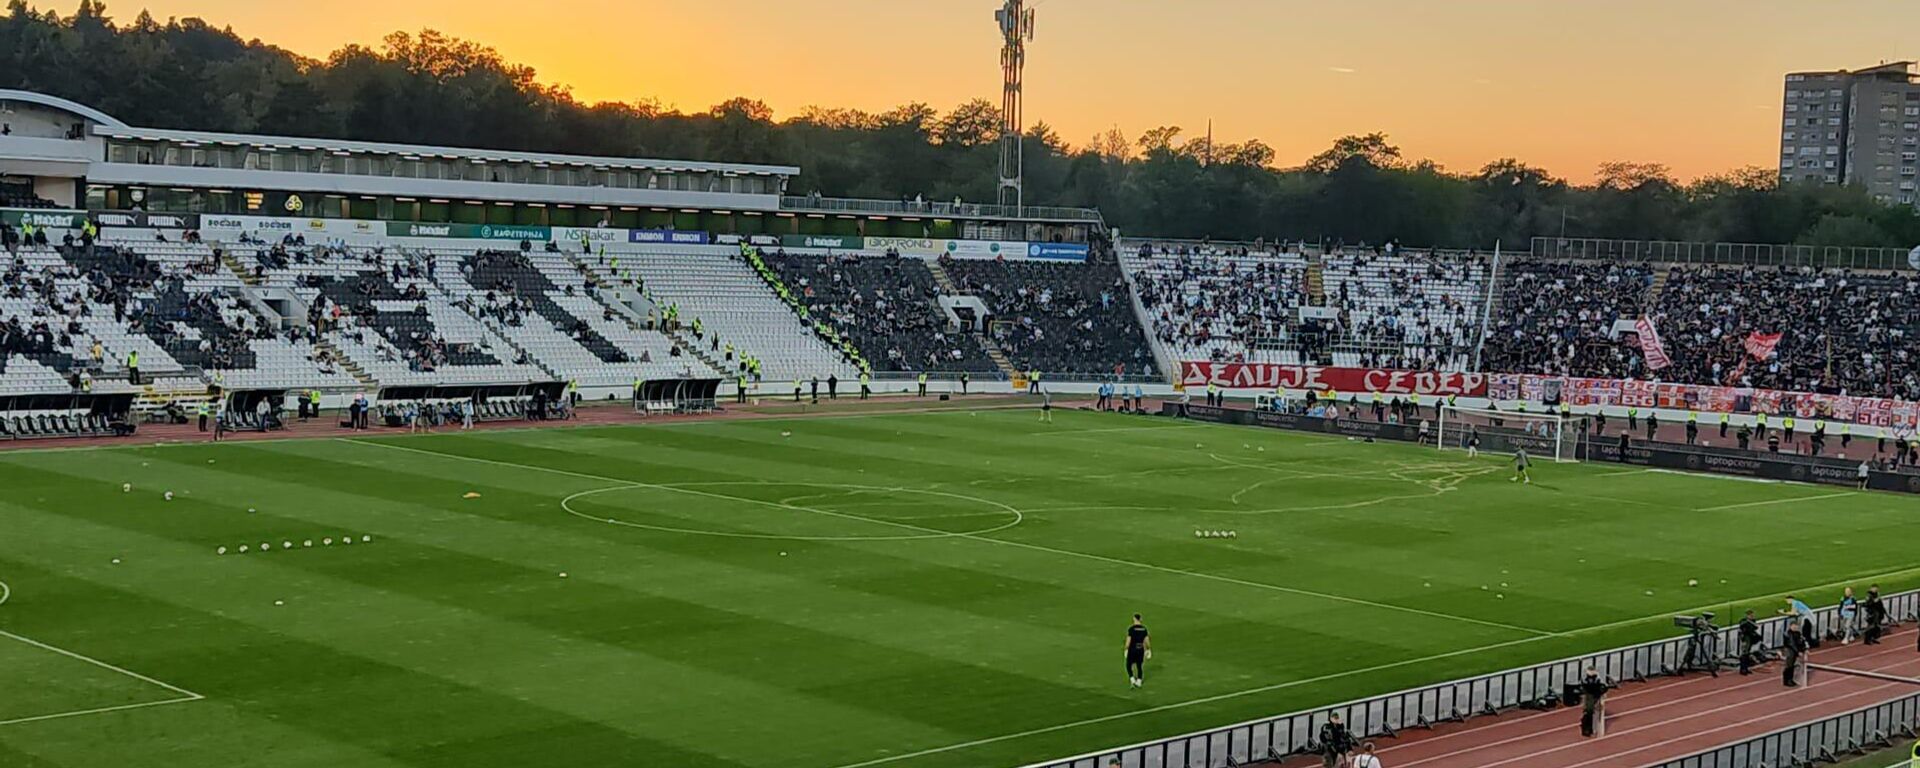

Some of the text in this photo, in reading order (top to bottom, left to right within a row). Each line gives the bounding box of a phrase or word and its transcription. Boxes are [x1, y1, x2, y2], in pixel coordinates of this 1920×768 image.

[98, 214, 127, 225] PUMA
[148, 216, 175, 226] PUMA
[1184, 362, 1483, 394] ДЕЛИЈЕ СЕВЕР
